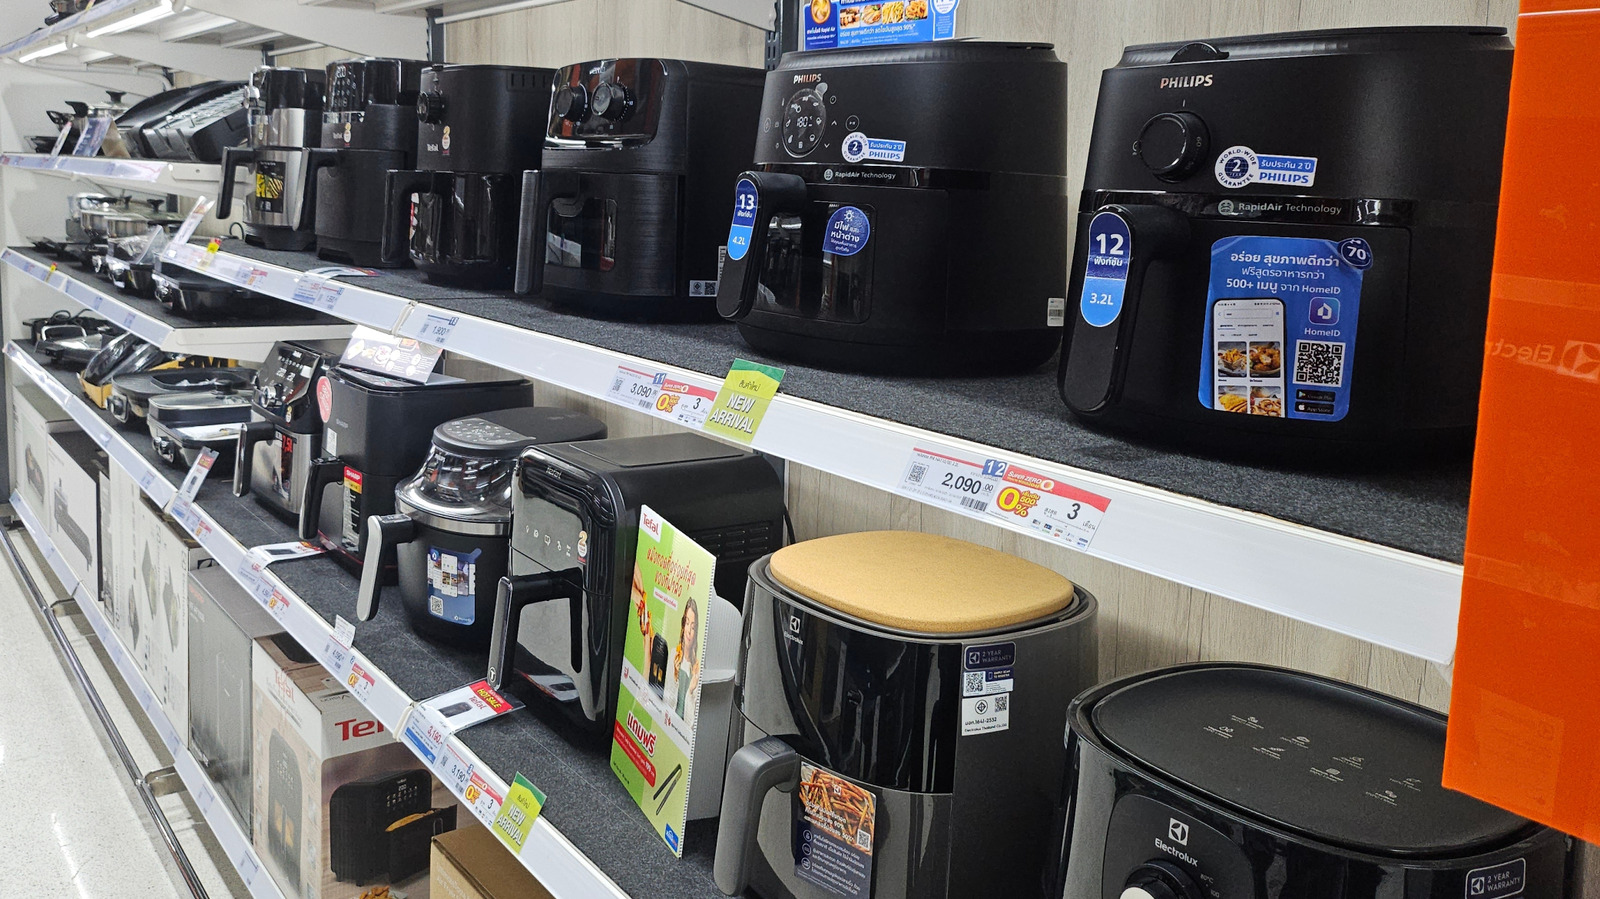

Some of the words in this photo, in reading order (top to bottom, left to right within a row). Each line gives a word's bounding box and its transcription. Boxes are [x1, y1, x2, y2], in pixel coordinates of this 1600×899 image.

[793, 73, 822, 84] PHILIPS
[1159, 73, 1214, 89] PHILIPS
[851, 141, 859, 151] 2
[869, 141, 893, 150] รับประกัน
[869, 150, 901, 160] PHILIPS
[1219, 149, 1257, 166] WORLD-WIDE
[1232, 159, 1241, 172] 2
[1261, 159, 1296, 169] รับประกัน
[1297, 162, 1303, 170] 2
[1304, 160, 1312, 170] ปี
[834, 170, 860, 179] RapidAir
[861, 171, 896, 180] Technology
[1218, 172, 1255, 187] GUARANTEE
[1259, 171, 1309, 184] PHILIPS
[739, 194, 755, 210] 13
[1238, 203, 1283, 213] RapidAir
[1286, 203, 1342, 215] Technology
[834, 220, 849, 231] มีไฟ
[732, 235, 746, 246] 4.2L
[830, 230, 860, 243] หน้าต่าง
[1095, 233, 1124, 256] 12
[1230, 250, 1261, 264] อร่อย
[1263, 253, 1340, 268] สุขภาพดีกว่า
[1346, 245, 1367, 260] 70
[1094, 254, 1123, 267] ฟังก์ชัน
[1241, 266, 1325, 280] ฟรีสูตรอาหารกว่า
[1226, 278, 1254, 289] 500+
[1257, 280, 1278, 294] เมนู
[1280, 283, 1300, 293] จาก
[1301, 284, 1341, 295] HomeID
[1089, 292, 1114, 306] 3.2L
[1304, 327, 1341, 338] HomeID
[630, 382, 652, 399] 3,090
[693, 397, 701, 410] 3
[726, 392, 756, 414] NEW
[709, 409, 753, 435] ARRIVAL
[941, 472, 982, 496] 2,090
[1008, 470, 1026, 481] SUPER
[1024, 474, 1043, 486] ZERO
[1067, 502, 1081, 520] 3
[643, 512, 659, 536] Tefal
[982, 655, 1012, 663] WARRANTY
[468, 695, 488, 710] Tefal
[486, 696, 502, 709] SALE
[627, 711, 656, 755] แถมฟรี
[451, 764, 466, 783] 3,190
[487, 798, 494, 810] 3
[508, 804, 527, 827] NEW
[497, 813, 524, 847] ARRIVAL
[1154, 837, 1198, 867] Electrolux
[1493, 871, 1510, 881] YEAR
[1487, 877, 1521, 892] WARRANTY
